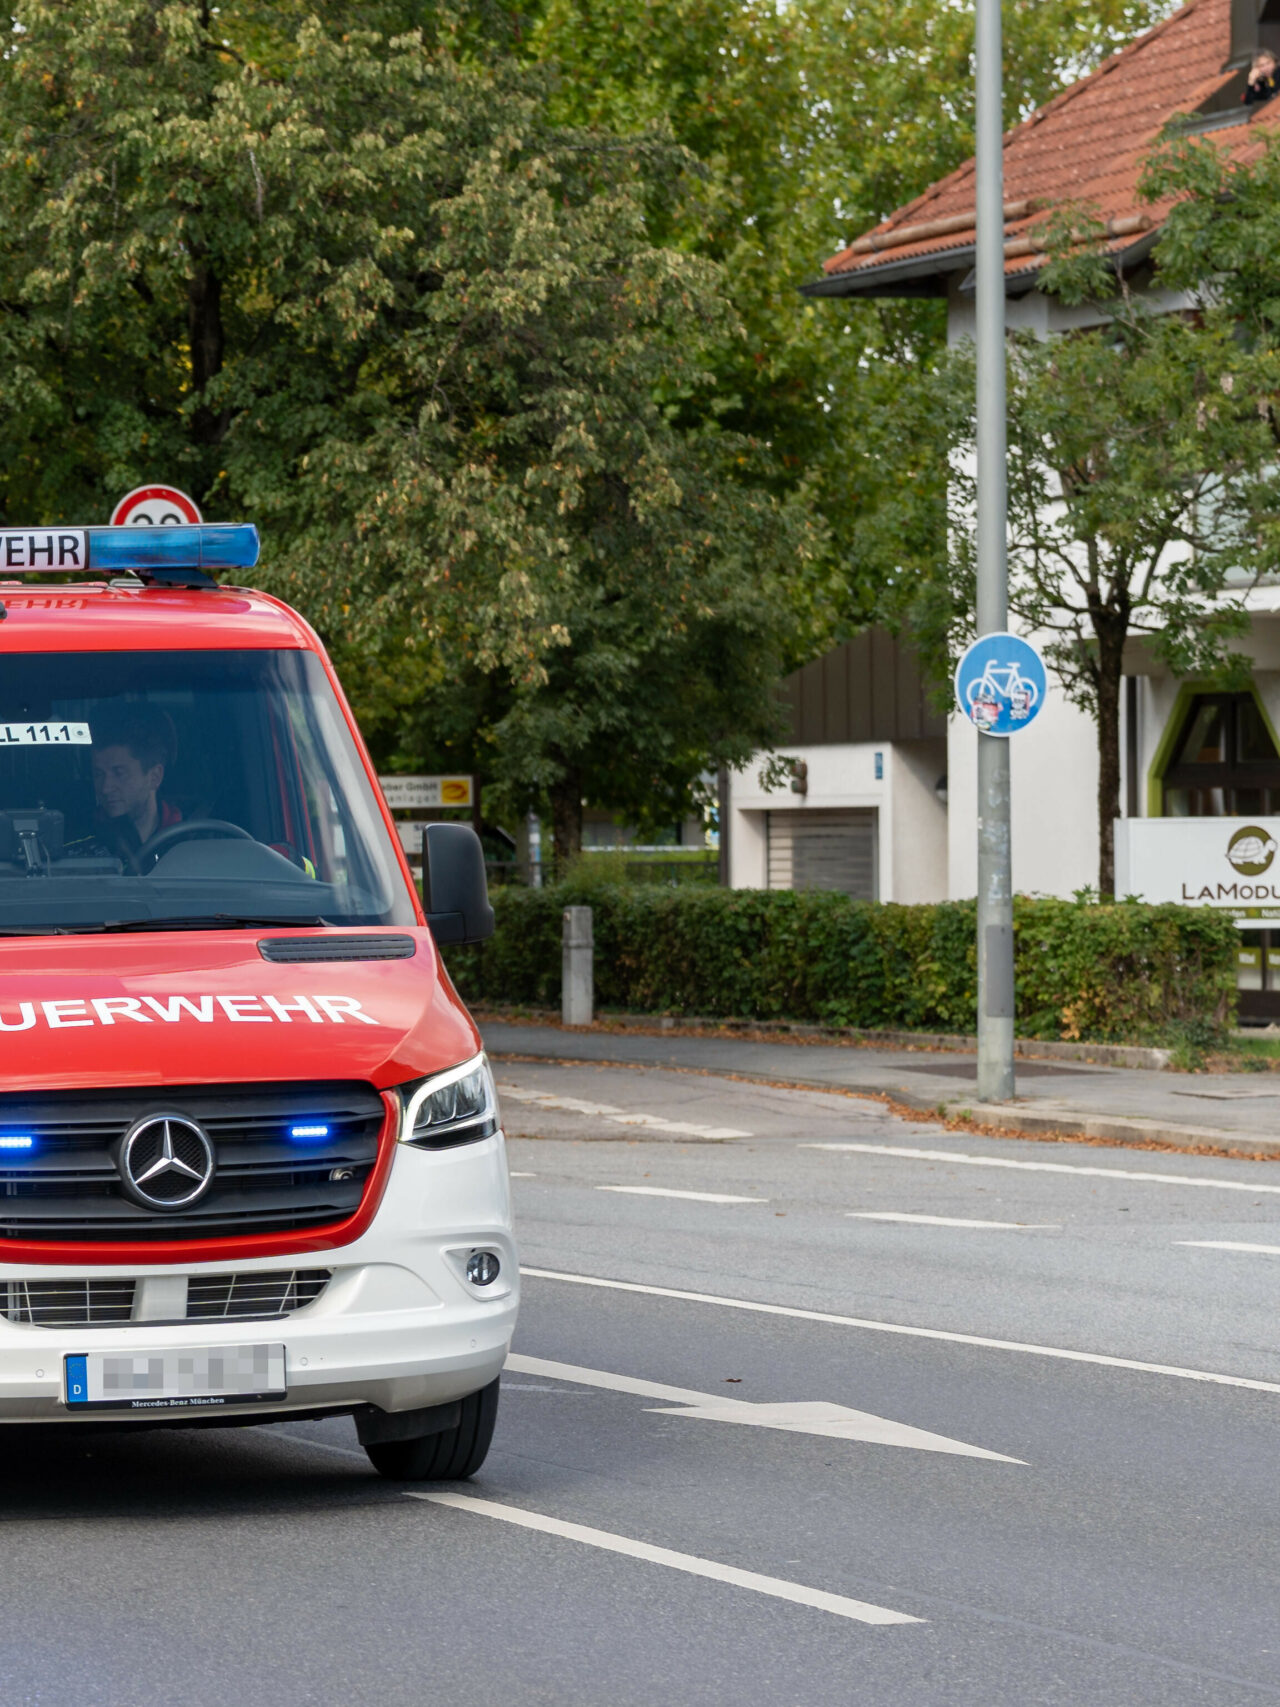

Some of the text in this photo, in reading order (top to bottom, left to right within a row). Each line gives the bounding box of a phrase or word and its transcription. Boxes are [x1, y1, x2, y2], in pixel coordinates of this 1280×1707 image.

[26, 725, 71, 741] 11.1
[73, 1384, 82, 1395] D
[131, 1397, 225, 1408] Mercedes-Benz München
